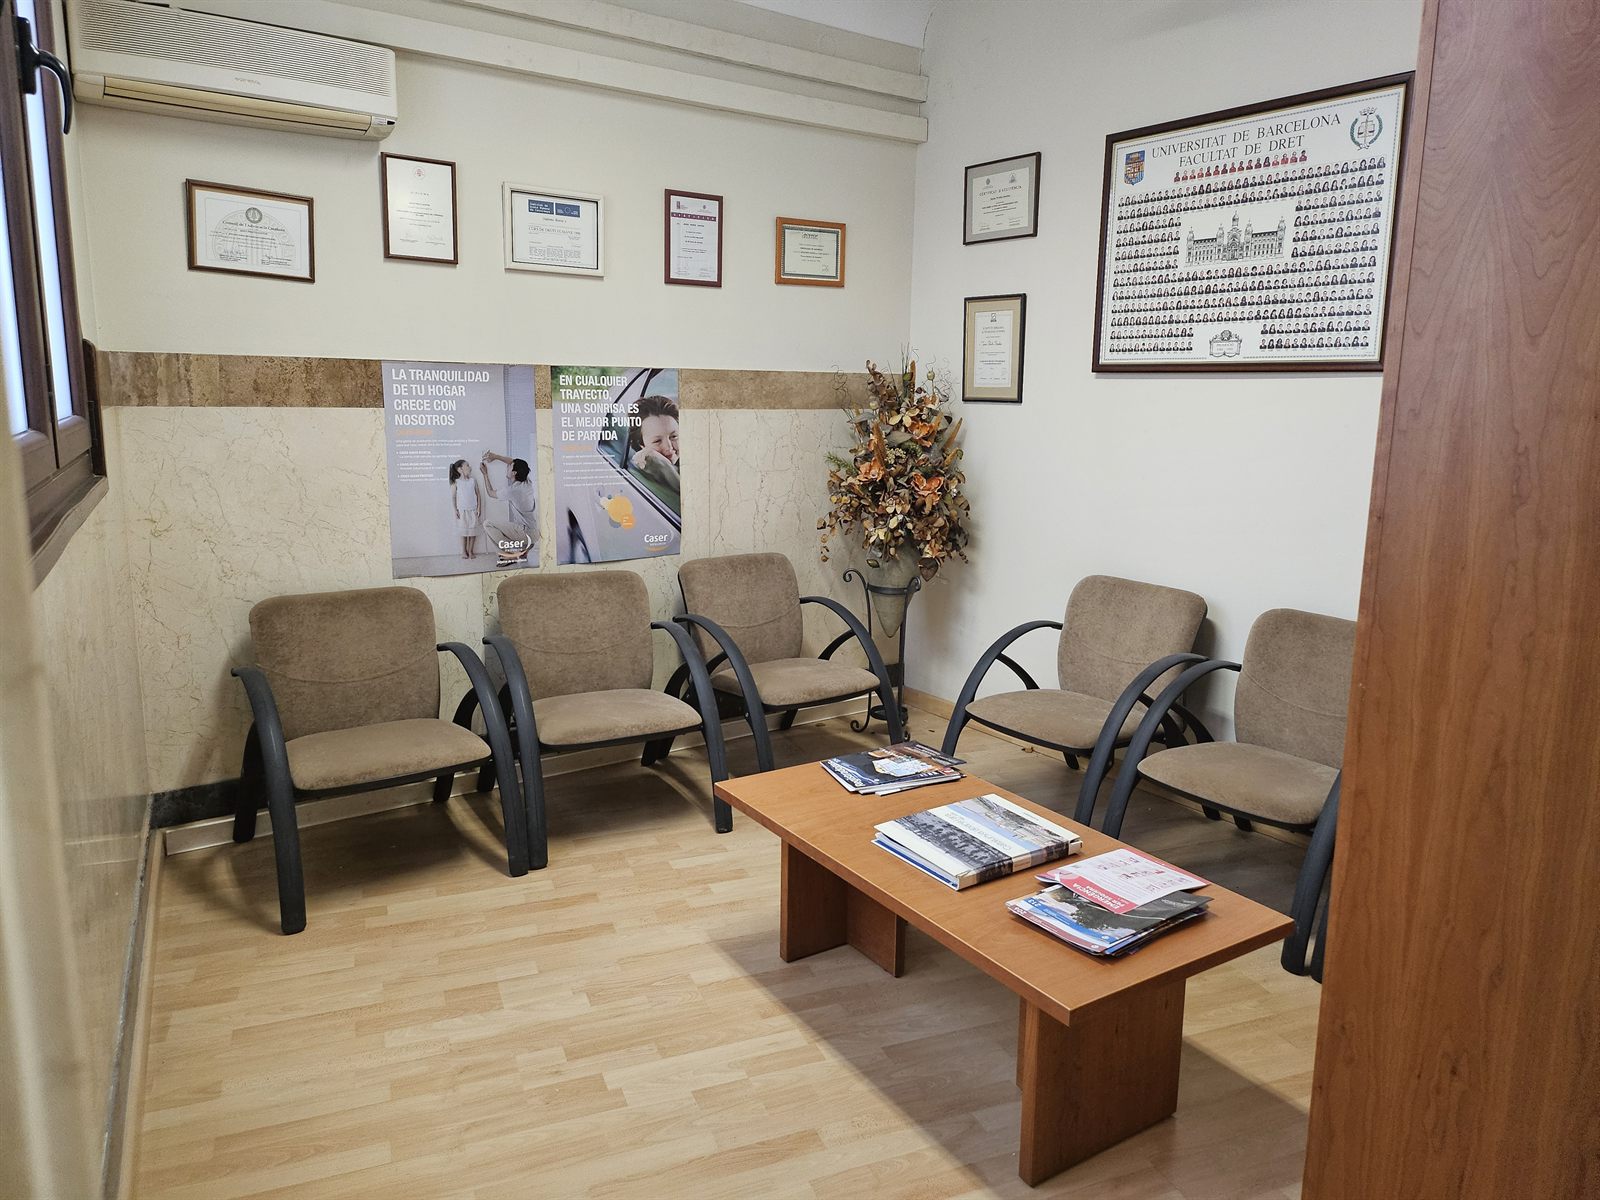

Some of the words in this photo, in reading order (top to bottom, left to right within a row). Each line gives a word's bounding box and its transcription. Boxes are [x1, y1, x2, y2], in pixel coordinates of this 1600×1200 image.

[1152, 134, 1226, 158] UNIVERSITAT
[1233, 129, 1250, 143] DE
[1257, 113, 1341, 139] BARCELONA
[1179, 146, 1238, 167] FACULTAT
[1244, 142, 1262, 156] DE
[1269, 134, 1305, 151] DRET
[392, 368, 407, 380] LA
[408, 369, 490, 383] TRANQUILIDAD
[559, 375, 573, 386] EN
[575, 375, 628, 387] CUALQUIER
[392, 383, 409, 396] DE
[410, 384, 425, 396] TU
[427, 384, 466, 397] HOGAR
[559, 389, 612, 401] TRAYECTO,
[393, 399, 431, 411] CRECE
[433, 400, 457, 411] CON
[561, 403, 582, 414] UNA
[583, 403, 626, 414] SONRISA
[627, 403, 640, 414] ES
[394, 414, 456, 426] NOSOTROS
[561, 416, 574, 428] EL
[576, 416, 609, 428] MEJOR
[611, 416, 642, 427] PUNTO
[561, 430, 575, 441] DE
[577, 430, 618, 441] PARTIDA
[498, 540, 525, 549] Caser
[644, 534, 668, 543] Caser
